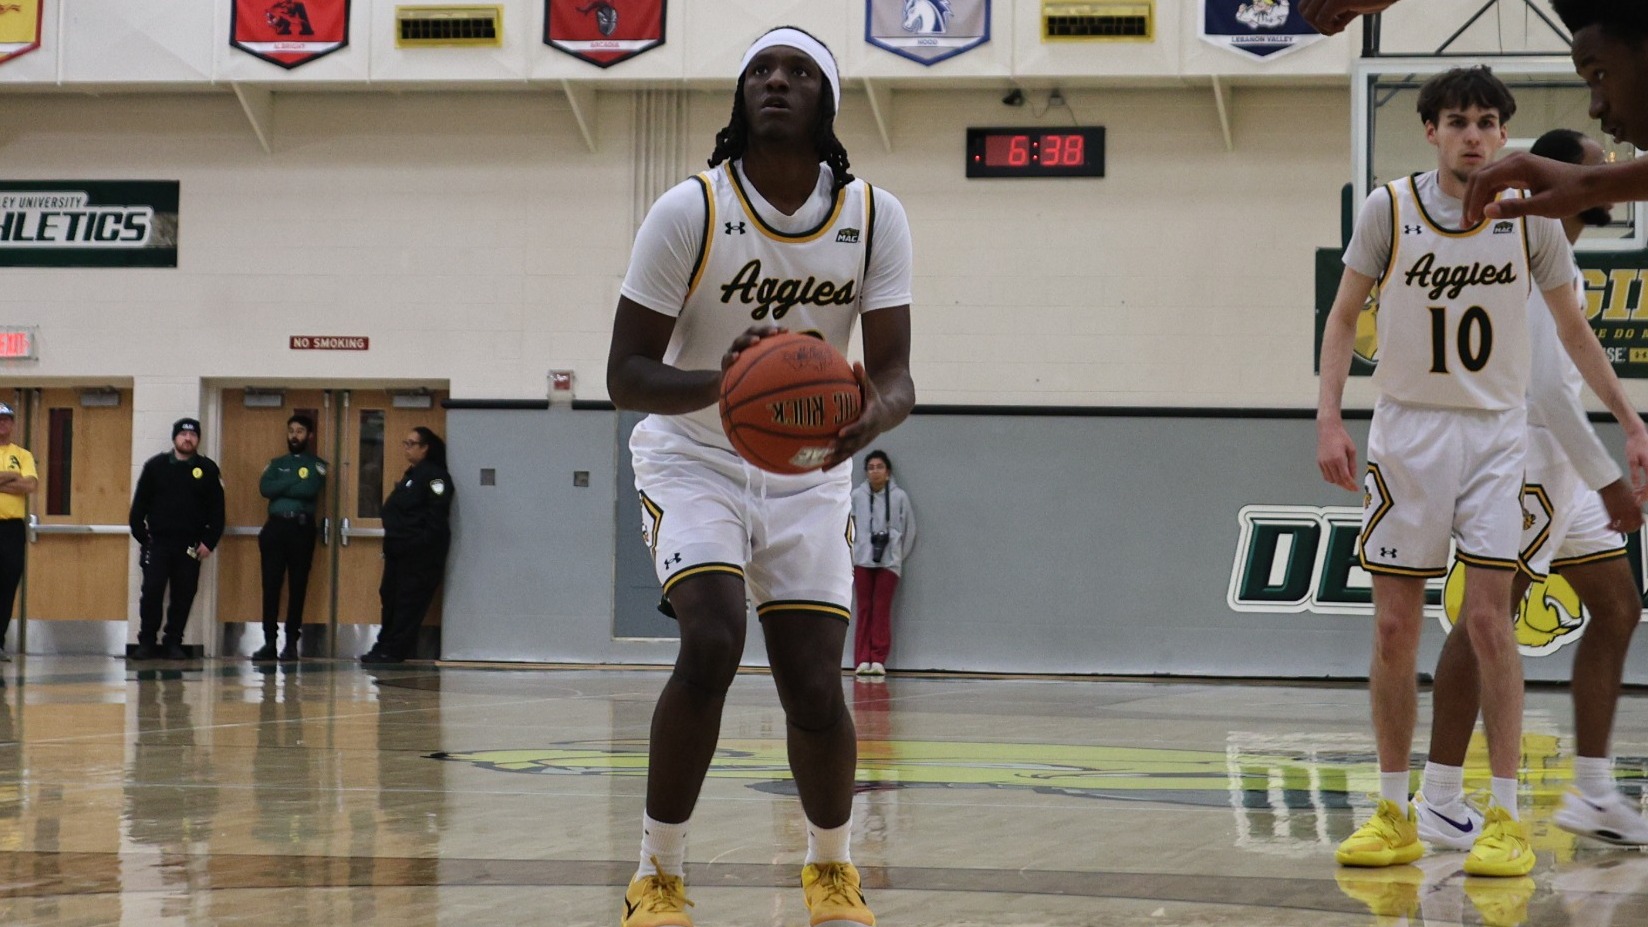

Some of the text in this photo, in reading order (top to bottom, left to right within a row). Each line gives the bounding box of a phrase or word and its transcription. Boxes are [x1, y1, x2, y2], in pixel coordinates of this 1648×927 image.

[1008, 135, 1084, 166] 6:38
[0, 197, 82, 208] EY UNIVERSITY
[837, 234, 858, 242] MAC
[1405, 252, 1517, 300] Aggies
[720, 258, 856, 320] Aggies
[293, 337, 365, 348] NO SMOKING
[1427, 305, 1493, 374] 10
[1614, 329, 1634, 338] DO
